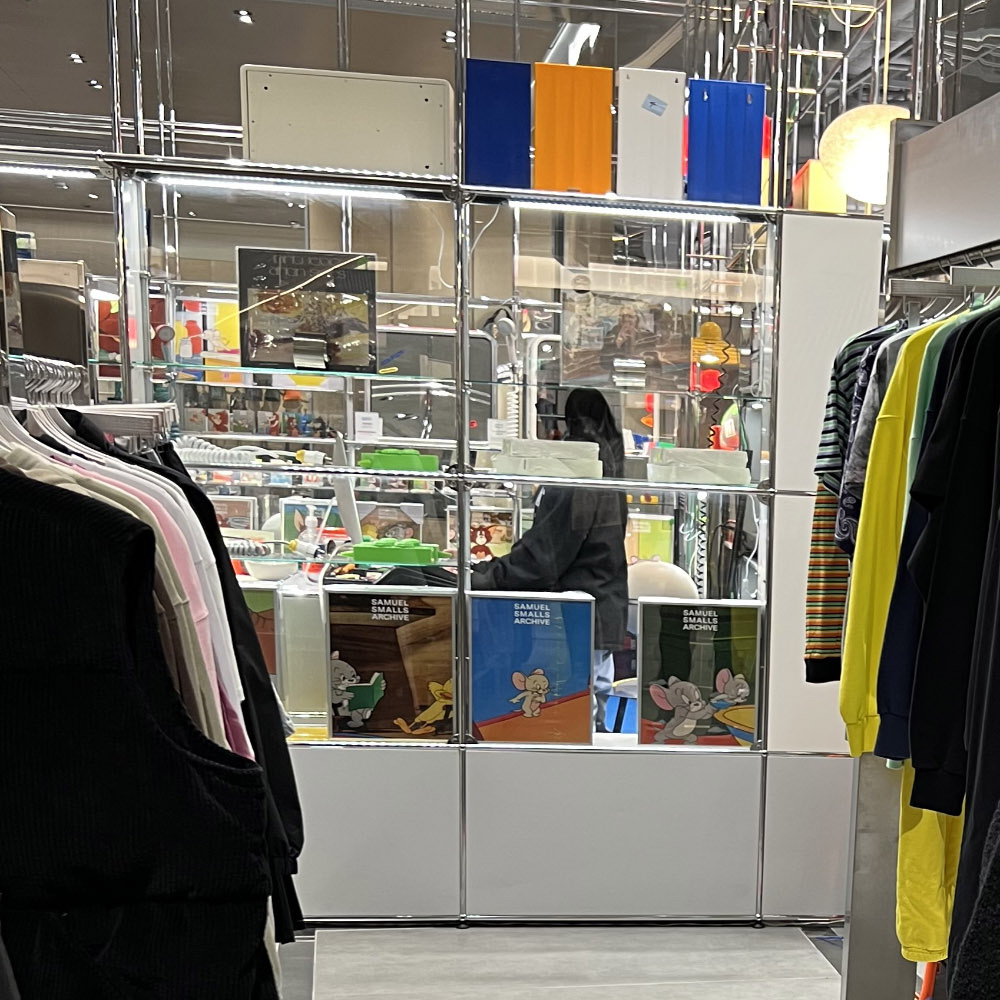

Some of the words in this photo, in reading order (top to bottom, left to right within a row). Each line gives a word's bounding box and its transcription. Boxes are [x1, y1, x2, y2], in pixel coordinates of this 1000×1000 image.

[371, 598, 409, 607] SAMUEL
[513, 602, 551, 611] SAMUEL
[371, 606, 409, 614] SMALLS
[513, 610, 551, 618] SMALLS
[682, 609, 719, 617] SAMUEL
[371, 613, 410, 621] ARCHIVE
[682, 616, 719, 624] SMALLS
[513, 617, 551, 626] ARCHIVE
[682, 623, 719, 632] ARCHIVE
